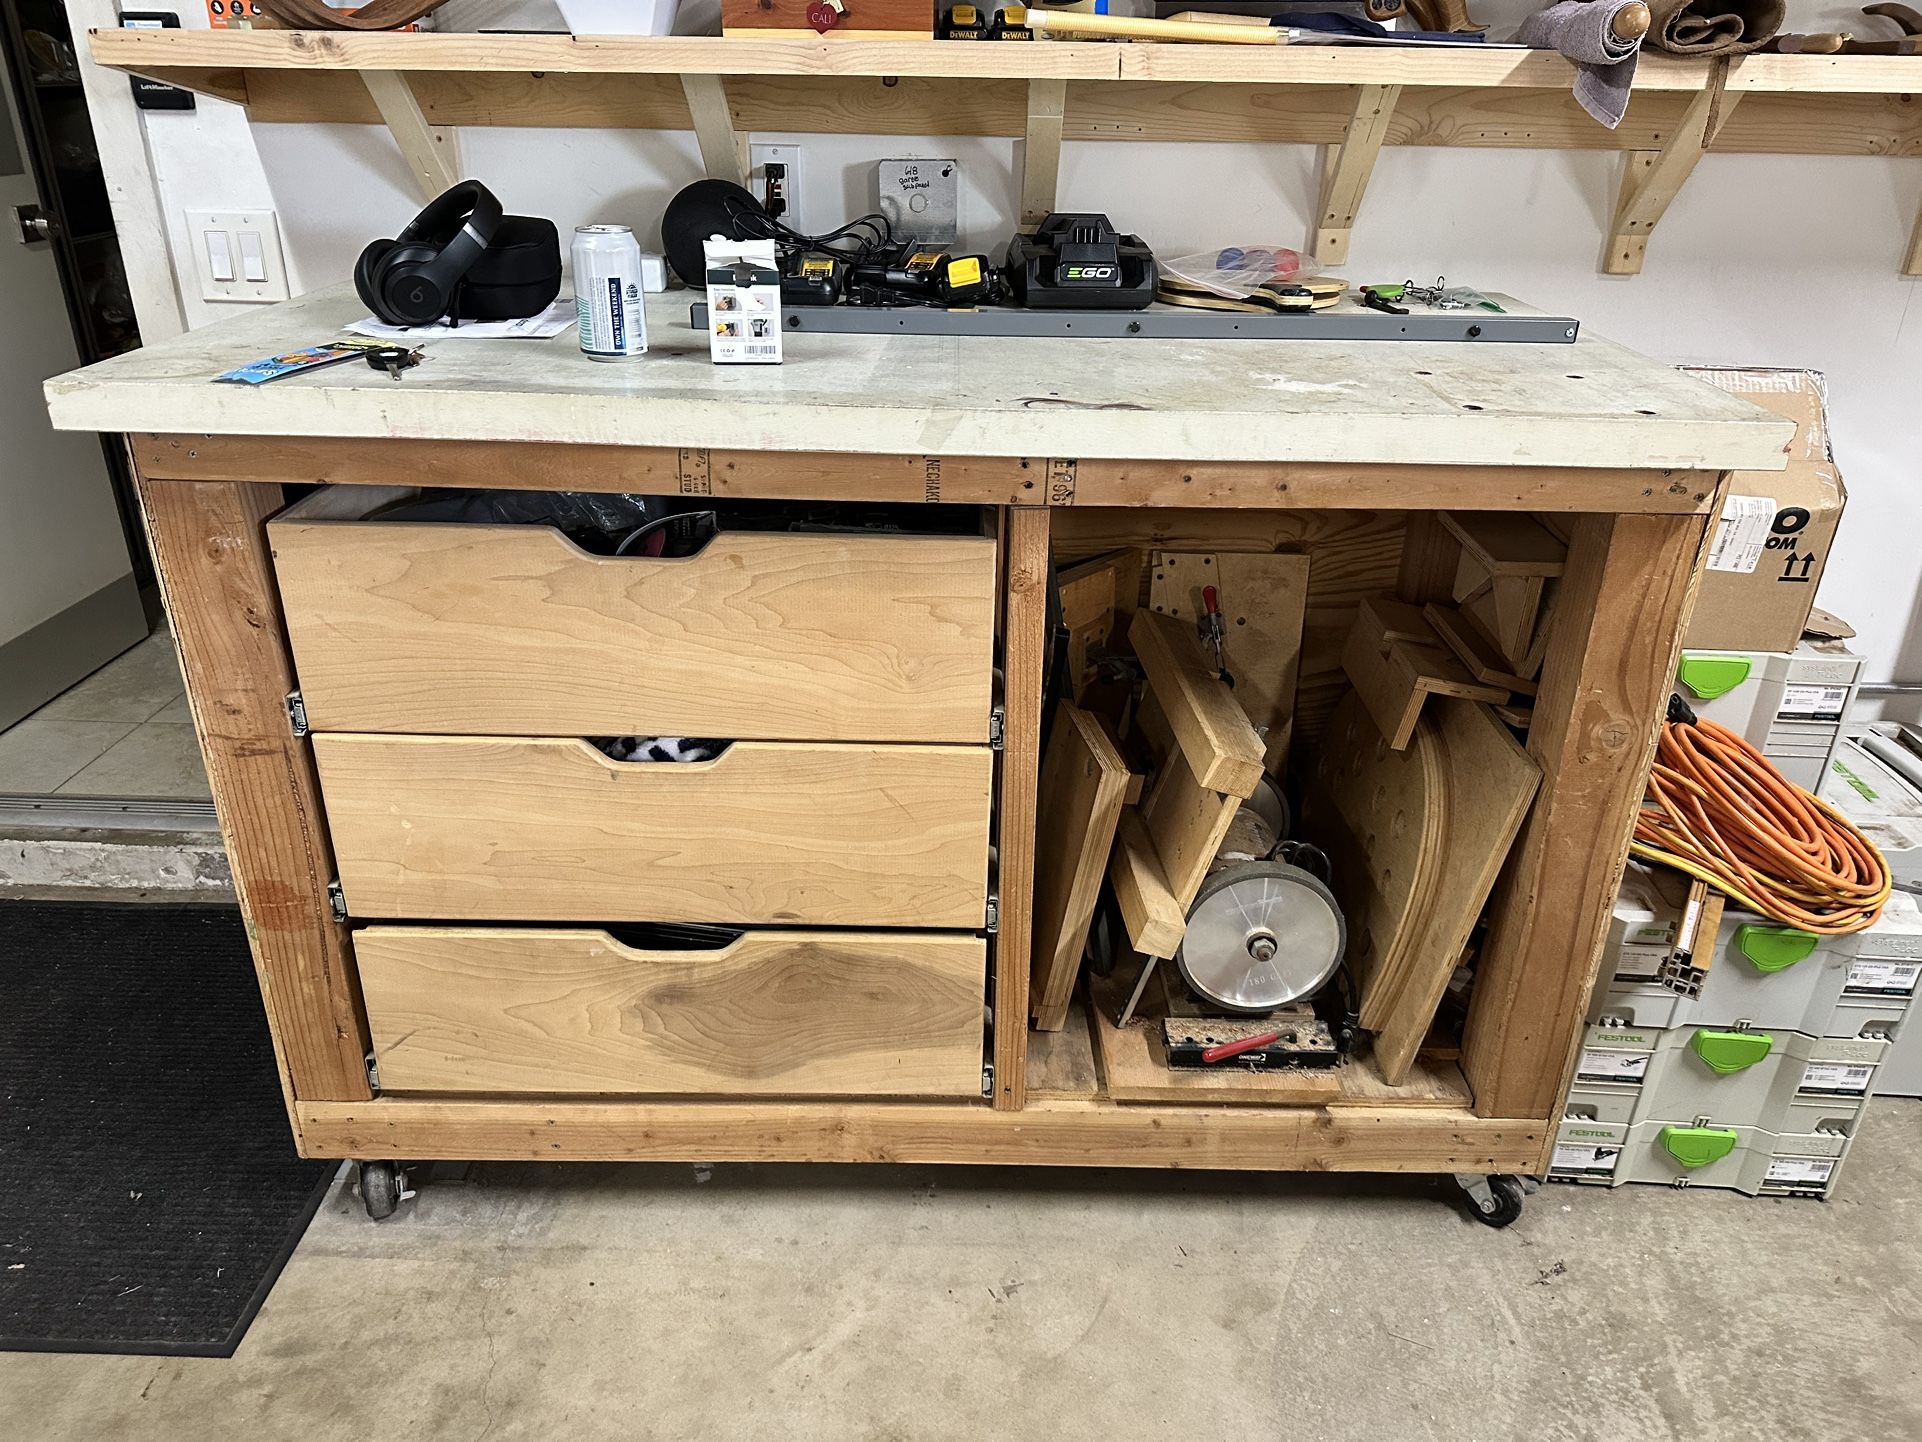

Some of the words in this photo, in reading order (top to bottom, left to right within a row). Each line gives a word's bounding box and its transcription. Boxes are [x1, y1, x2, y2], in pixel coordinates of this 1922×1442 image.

[811, 12, 832, 24] CALI
[1067, 267, 1112, 278] EGO
[610, 283, 619, 315] WEEKEND
[613, 316, 621, 329] THE
[614, 330, 622, 346] OWN
[683, 473, 692, 493] STUD
[1764, 536, 1798, 550] OM
[1597, 1034, 1646, 1043] FESTOOL
[1568, 1129, 1615, 1138] FESTOOL
